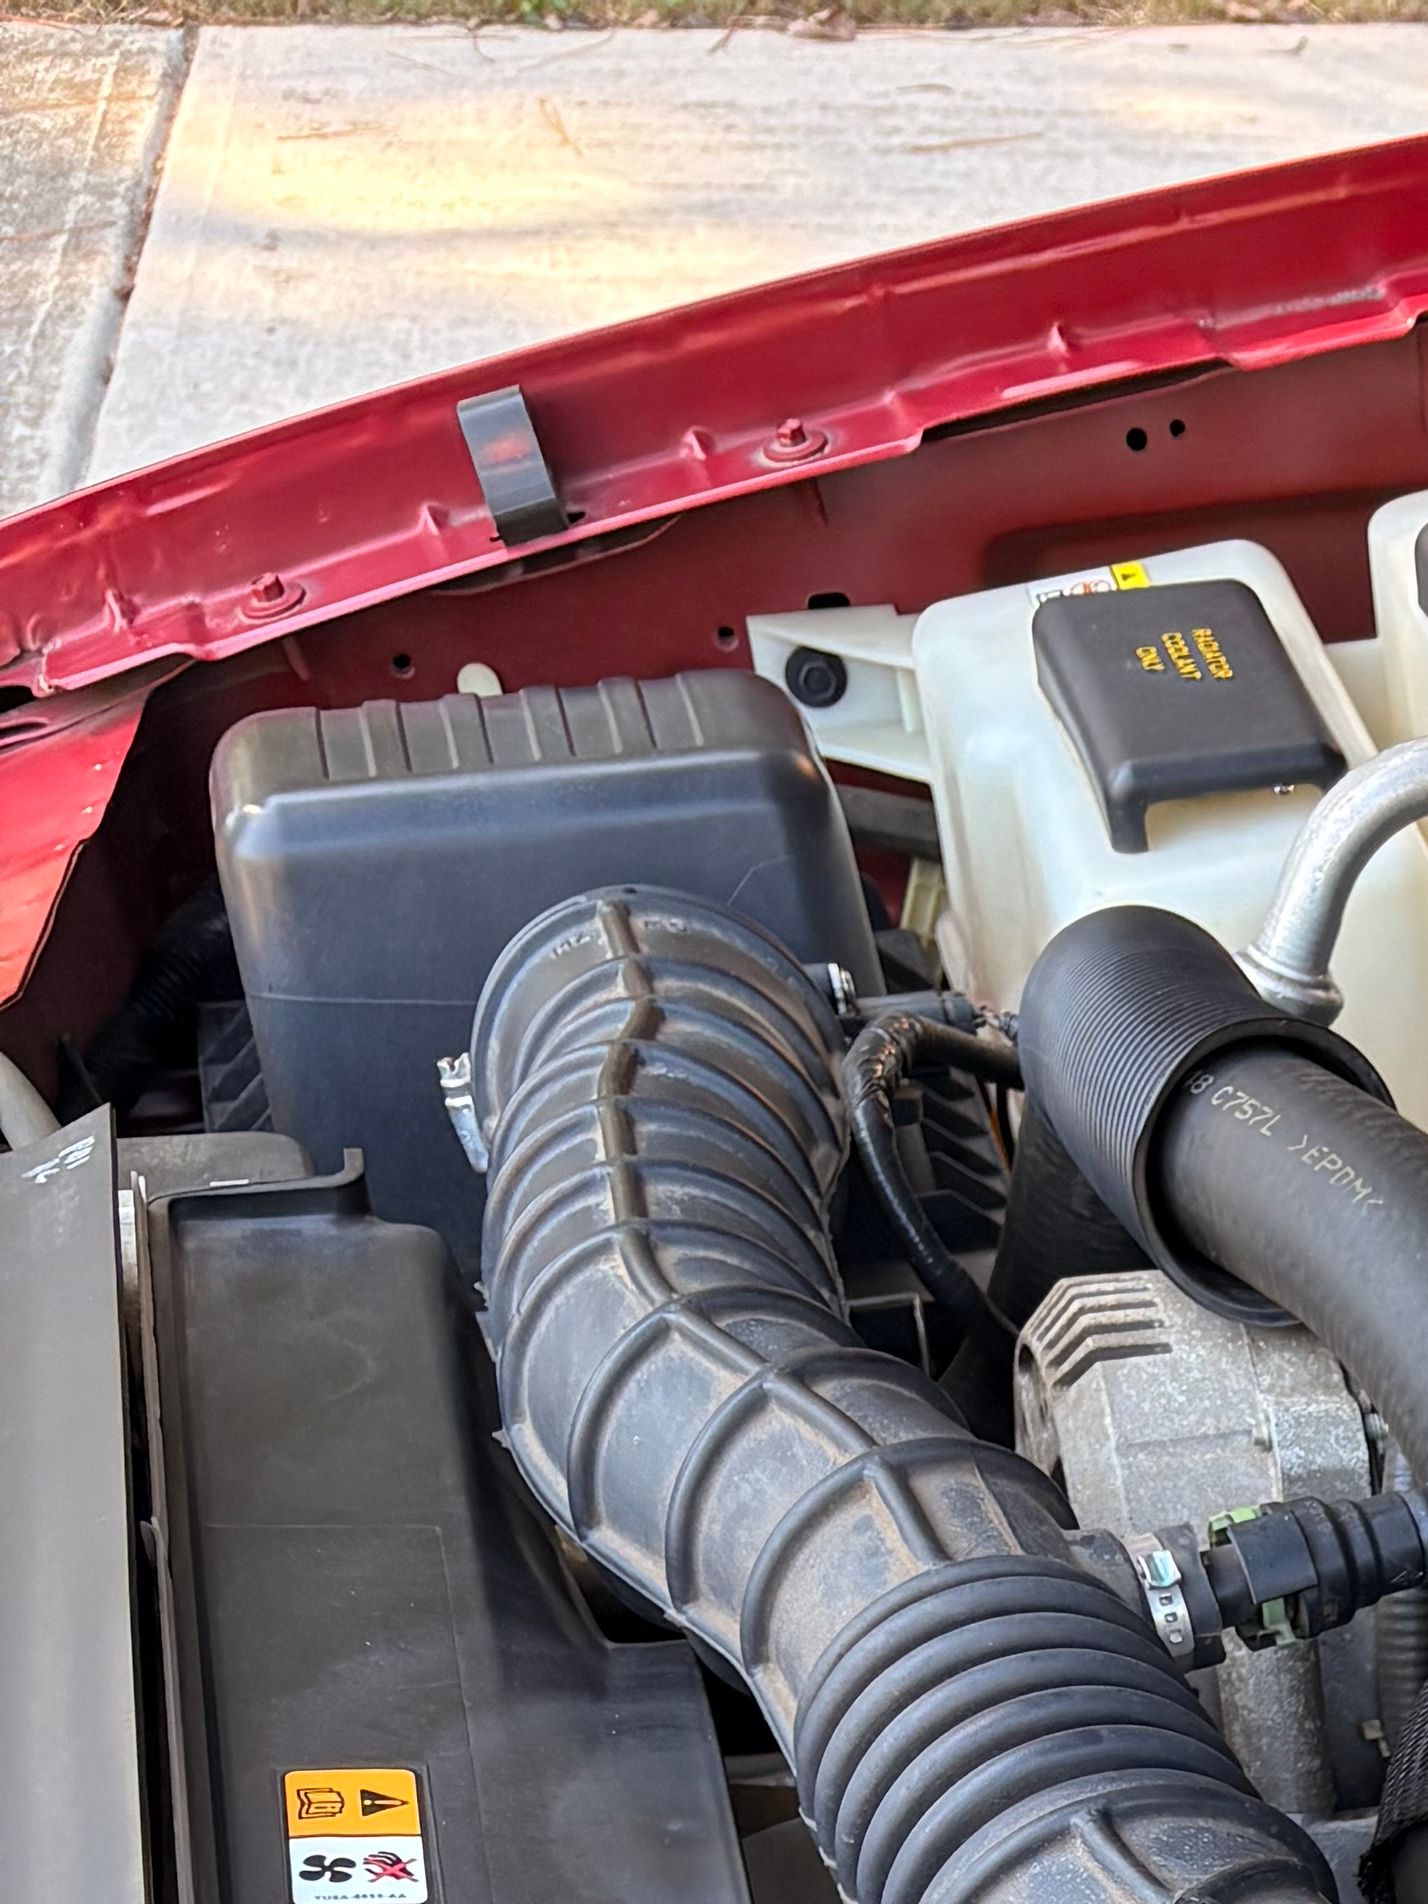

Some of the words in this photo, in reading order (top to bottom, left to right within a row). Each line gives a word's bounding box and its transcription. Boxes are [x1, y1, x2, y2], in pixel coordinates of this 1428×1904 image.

[1136, 646, 1165, 672] ONLY
[1161, 632, 1202, 680] COOLANT
[1191, 628, 1233, 679] RADIATOR
